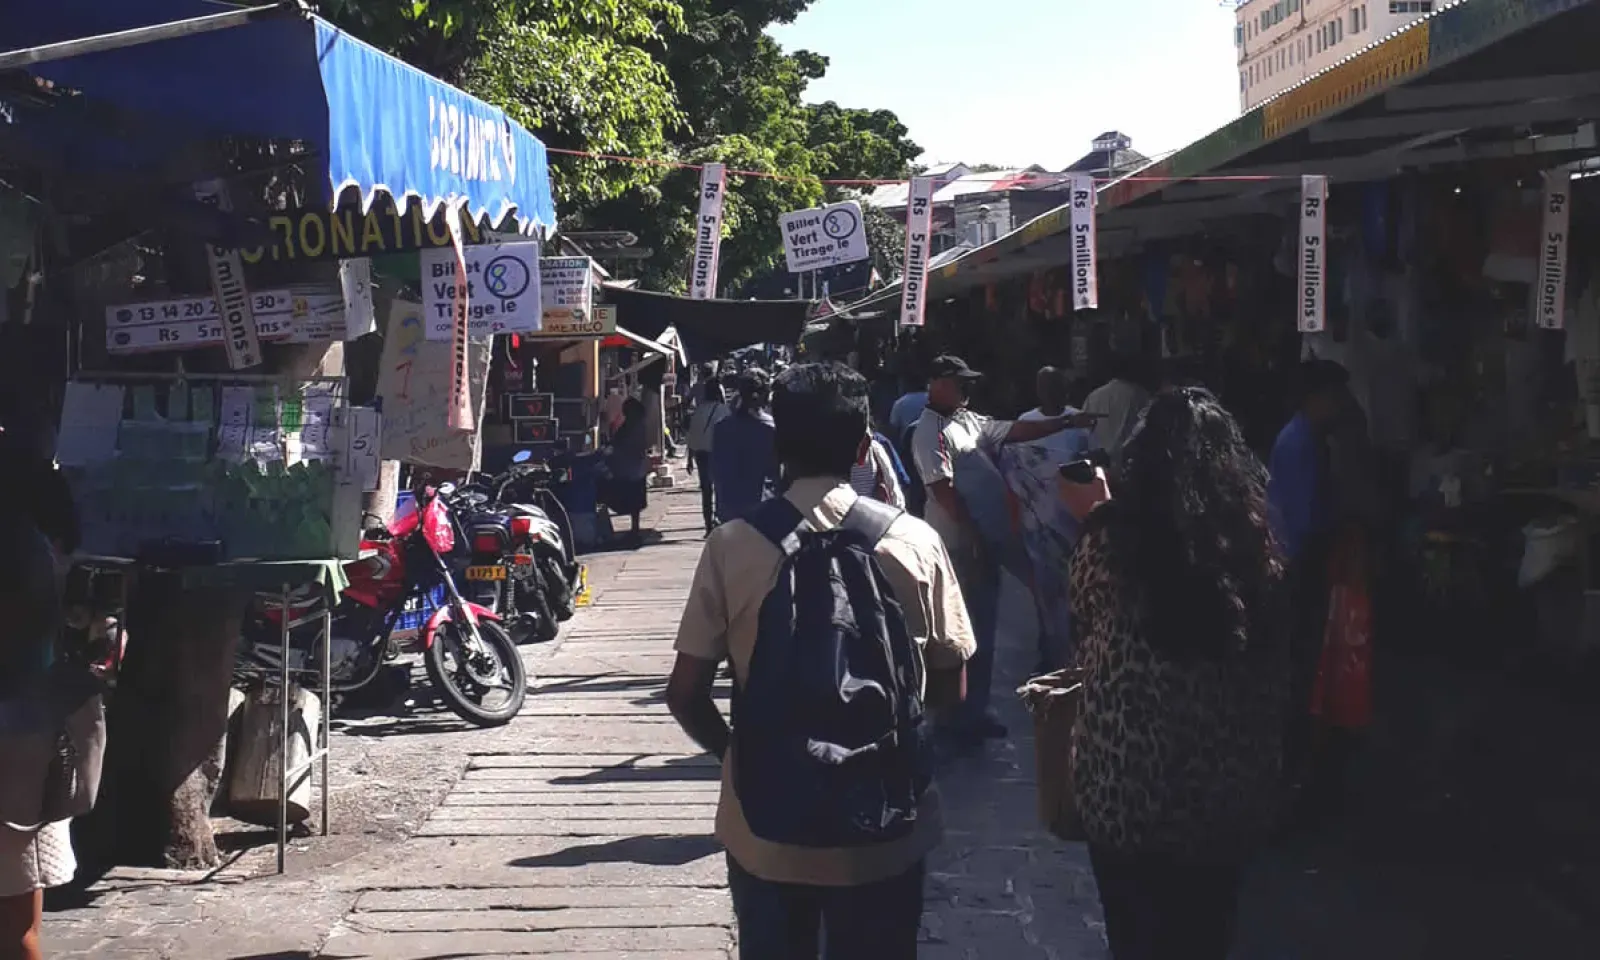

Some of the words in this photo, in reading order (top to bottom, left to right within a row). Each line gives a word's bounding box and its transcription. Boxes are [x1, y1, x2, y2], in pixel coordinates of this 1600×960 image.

[704, 182, 719, 200] Rs
[1075, 190, 1088, 209] Rs
[913, 197, 926, 216] Rs
[1305, 197, 1319, 217] Rs
[1549, 193, 1564, 214] Rs
[787, 216, 820, 232] Billet
[790, 231, 817, 246] Vert
[792, 244, 833, 258] Tirage
[837, 240, 849, 249] le
[432, 262, 480, 278] Bilet
[434, 284, 474, 299] Vet
[138, 307, 155, 320] 13
[162, 304, 179, 318] 14
[185, 302, 203, 316] 20
[256, 295, 275, 309] 30
[434, 303, 494, 319] Tige
[501, 300, 517, 314] le
[159, 327, 180, 341] Rs
